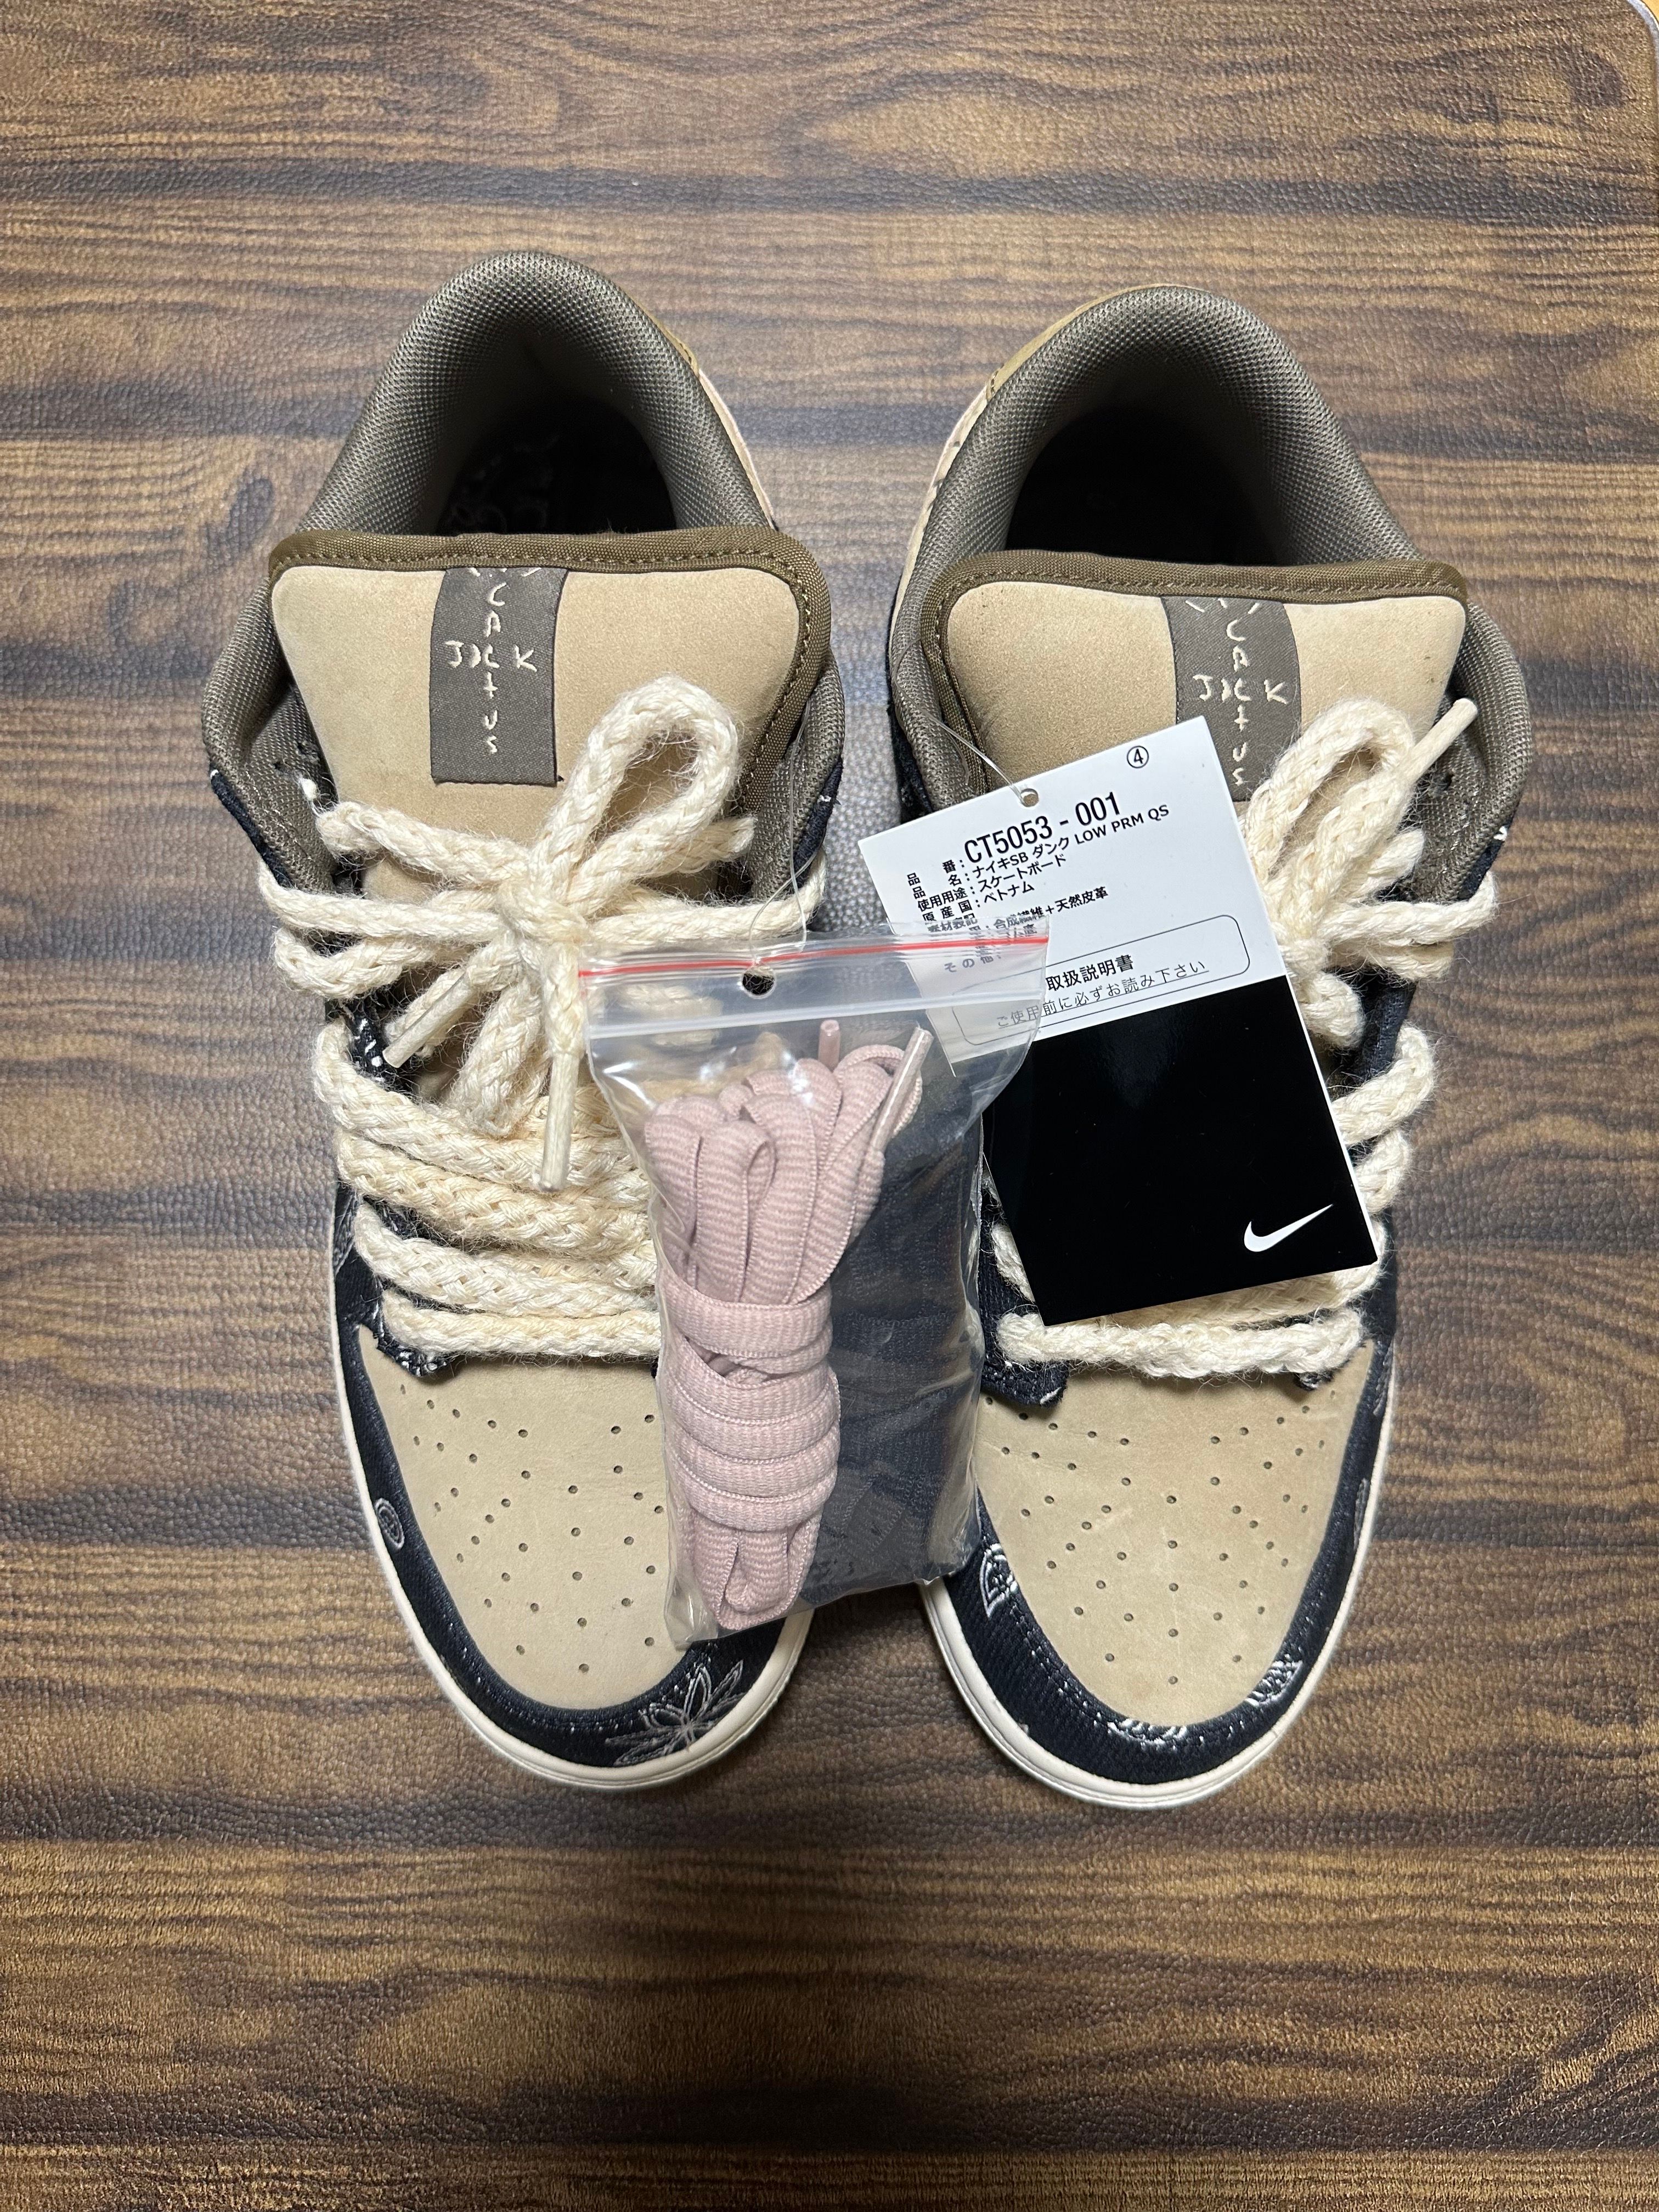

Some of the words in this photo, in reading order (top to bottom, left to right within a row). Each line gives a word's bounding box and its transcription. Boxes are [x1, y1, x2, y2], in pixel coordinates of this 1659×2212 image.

[964, 815, 1053, 864] CT5053
[1075, 792, 1120, 826] 001
[972, 851, 1029, 879] ナイキSB
[1032, 837, 1069, 859] ダンク
[1074, 824, 1107, 845] LOW
[1111, 812, 1144, 833] PRM
[1148, 804, 1170, 821] QS
[978, 853, 1066, 893] スケートボード
[984, 881, 1035, 904] ベトナム
[1045, 954, 1134, 992] 取扱説明書
